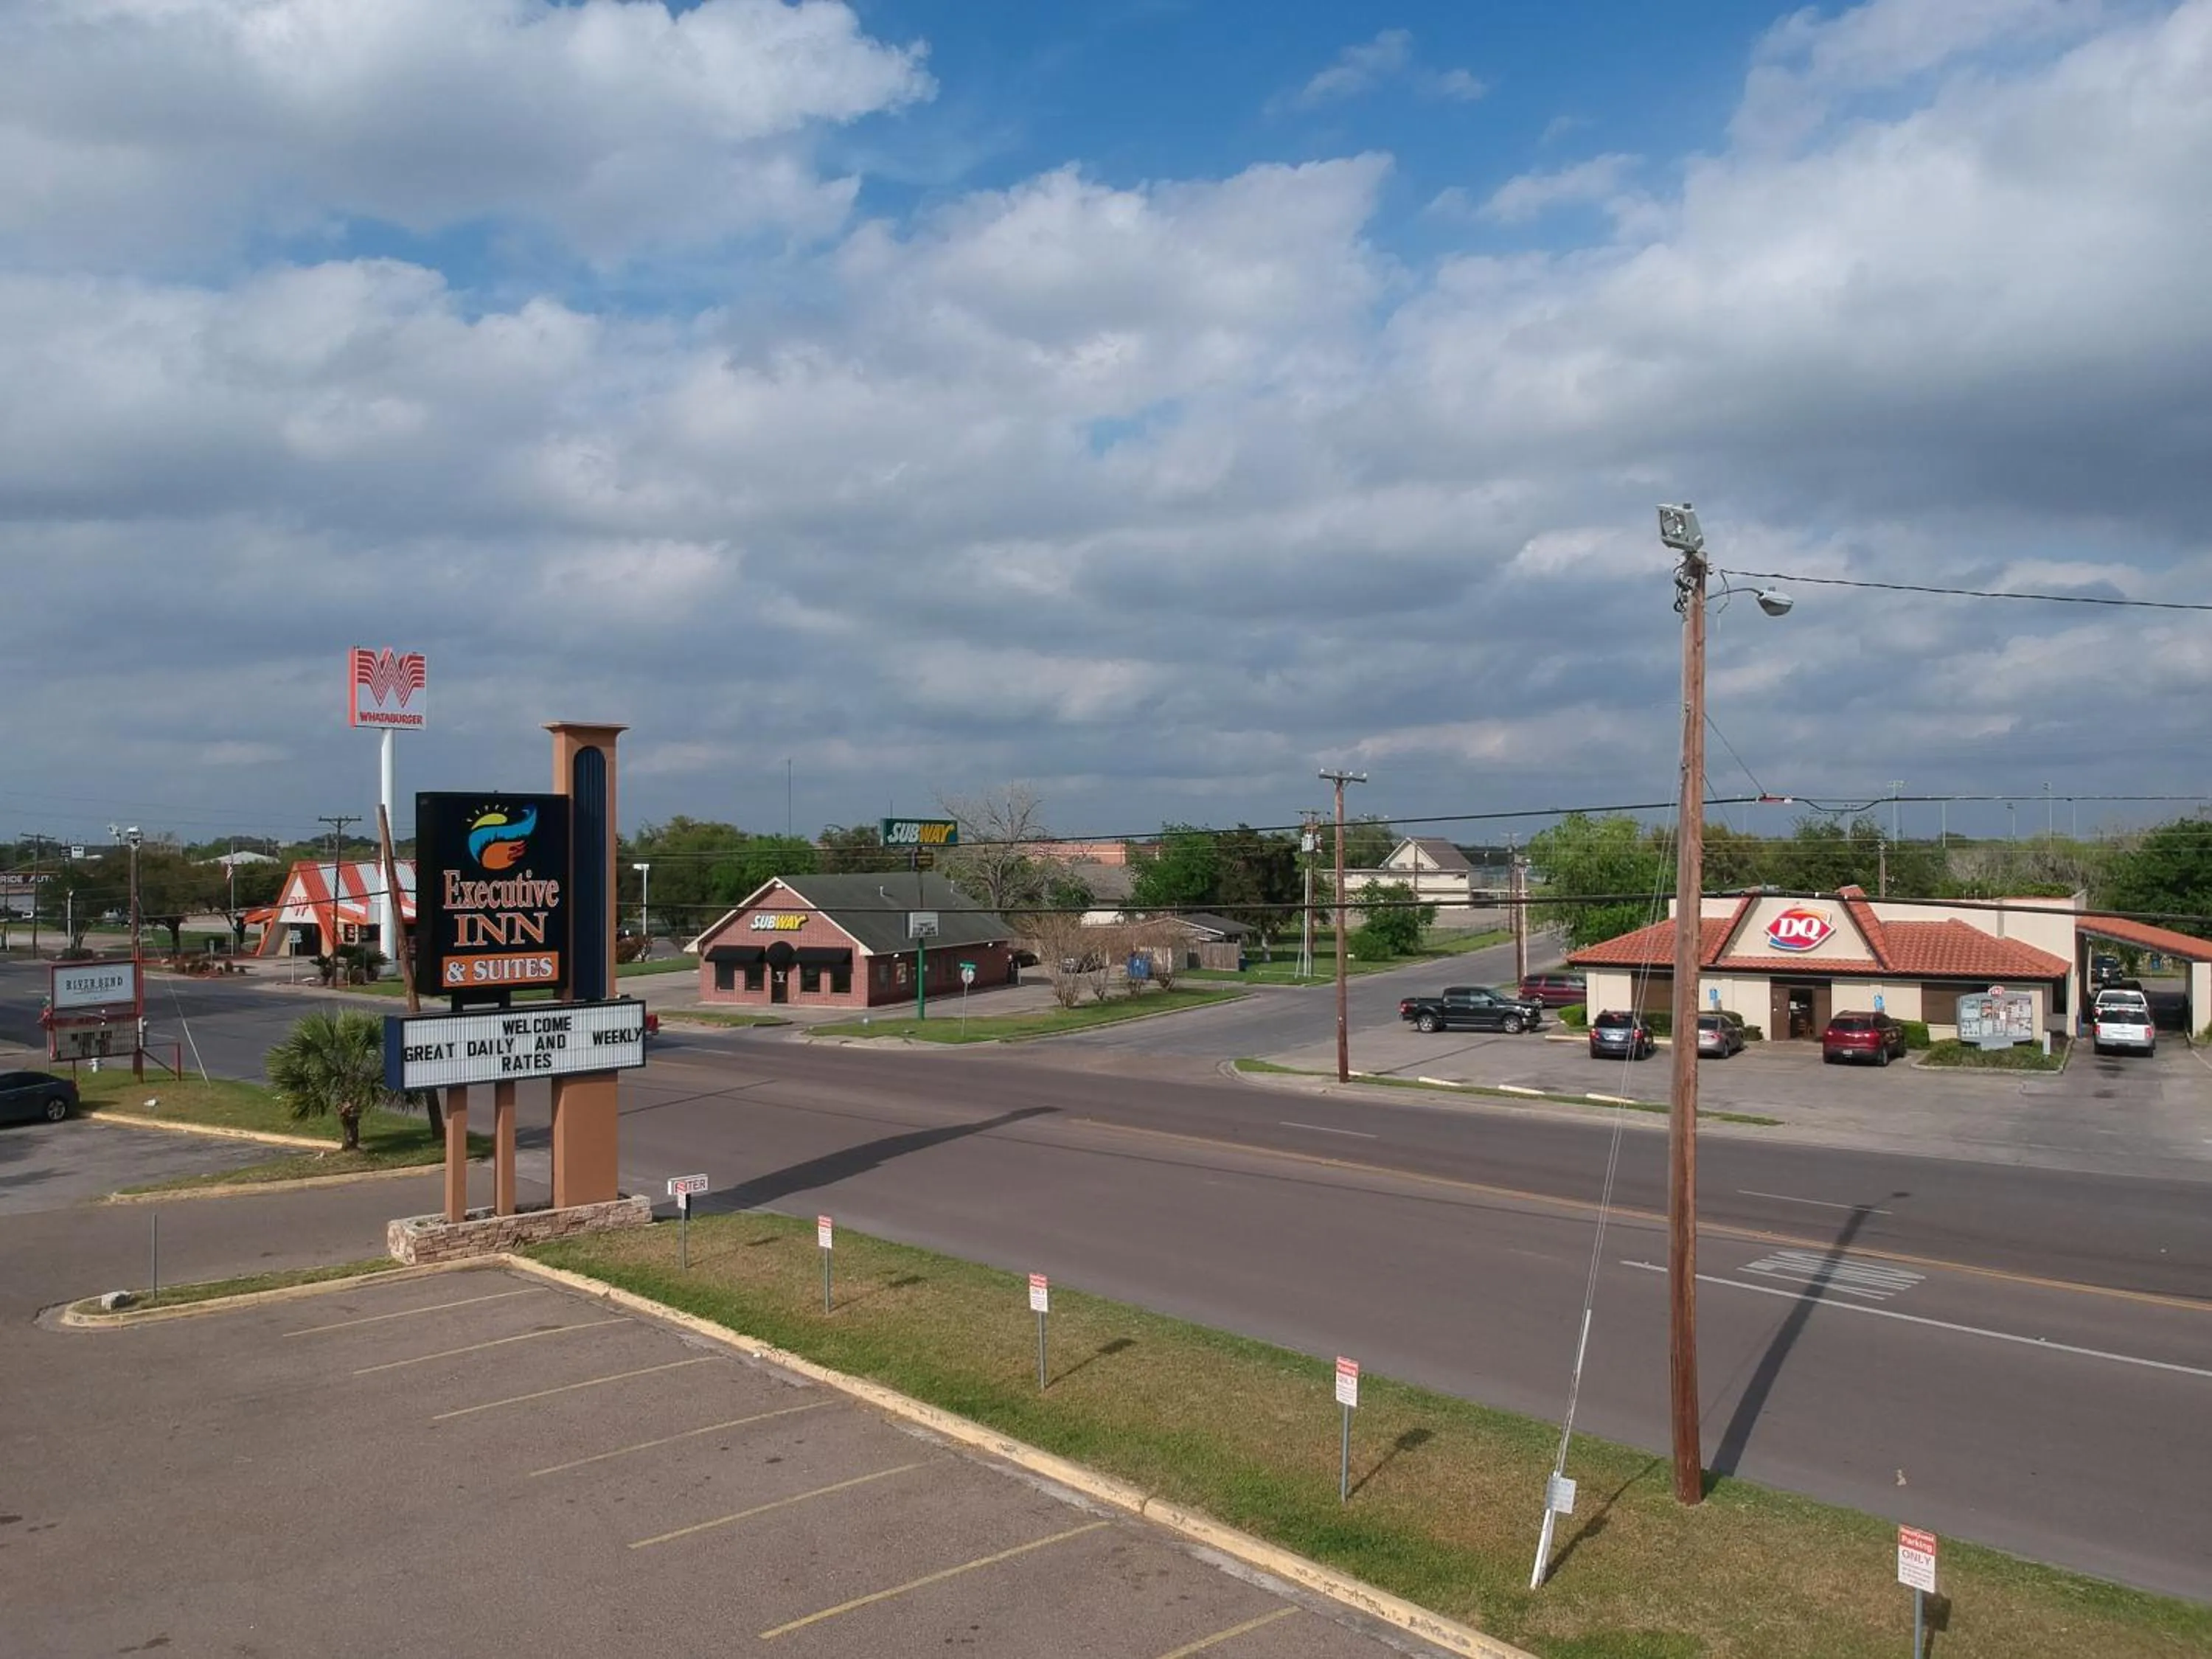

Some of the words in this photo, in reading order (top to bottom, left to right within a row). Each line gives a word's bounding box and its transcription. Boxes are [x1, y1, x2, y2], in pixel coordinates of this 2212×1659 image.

[360, 712, 422, 725] WHATABURGER
[887, 822, 955, 843] SUBWAY
[443, 869, 560, 908] Executive
[454, 911, 549, 947] INN
[750, 915, 806, 929] SUBWAY
[1778, 917, 1819, 940] DQ
[446, 961, 466, 983] &
[473, 957, 553, 981] SUITES
[503, 1017, 572, 1035] WELCOME
[403, 1043, 455, 1062] GREAT
[467, 1038, 514, 1057] DAILY
[535, 1034, 566, 1051] AND
[593, 1027, 643, 1046] WEEKLY
[502, 1053, 552, 1071] RATES
[1902, 1549, 1932, 1565] ONLY
